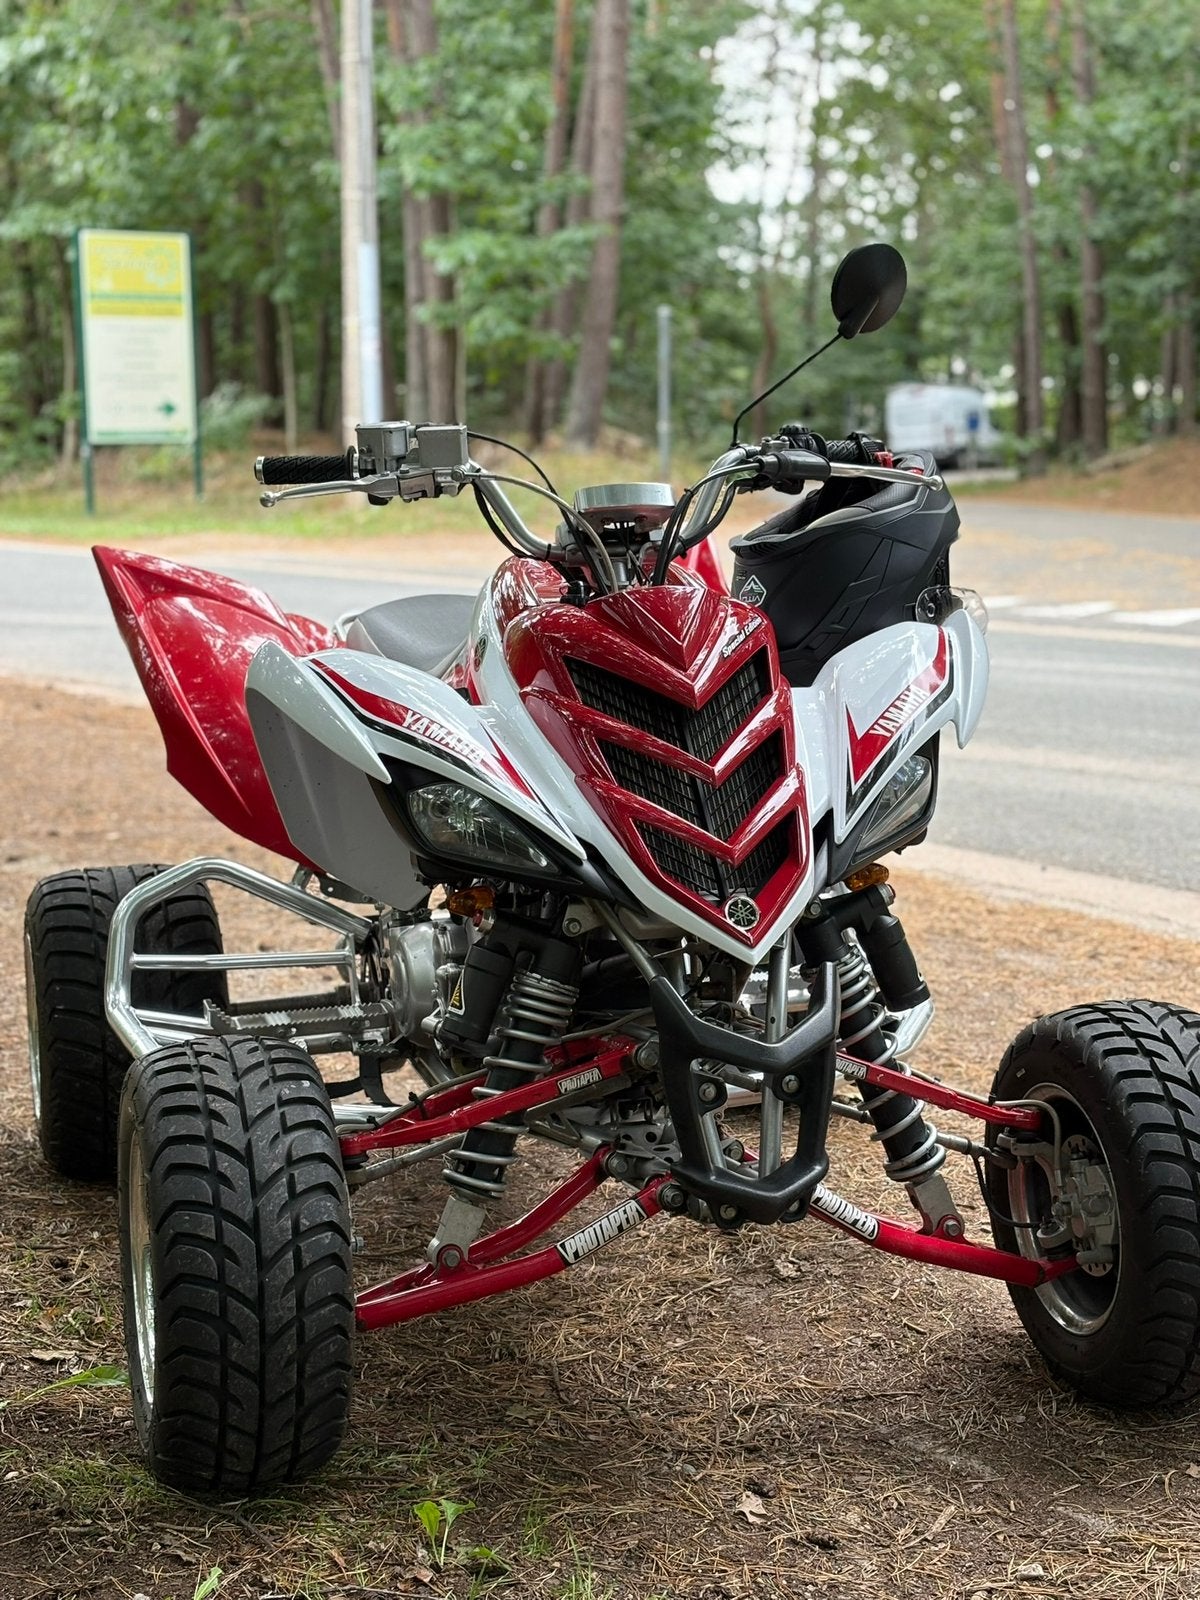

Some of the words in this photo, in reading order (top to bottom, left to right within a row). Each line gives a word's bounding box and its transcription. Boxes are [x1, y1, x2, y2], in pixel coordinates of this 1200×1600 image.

[721, 630, 746, 658] Special
[745, 614, 763, 636] Edition
[402, 710, 485, 763] YAMAHA
[868, 683, 931, 738] YAMAHA
[561, 1069, 600, 1093] PROTAPER
[565, 1204, 640, 1261] PROTAPER
[814, 1186, 877, 1238] PROTAPER
